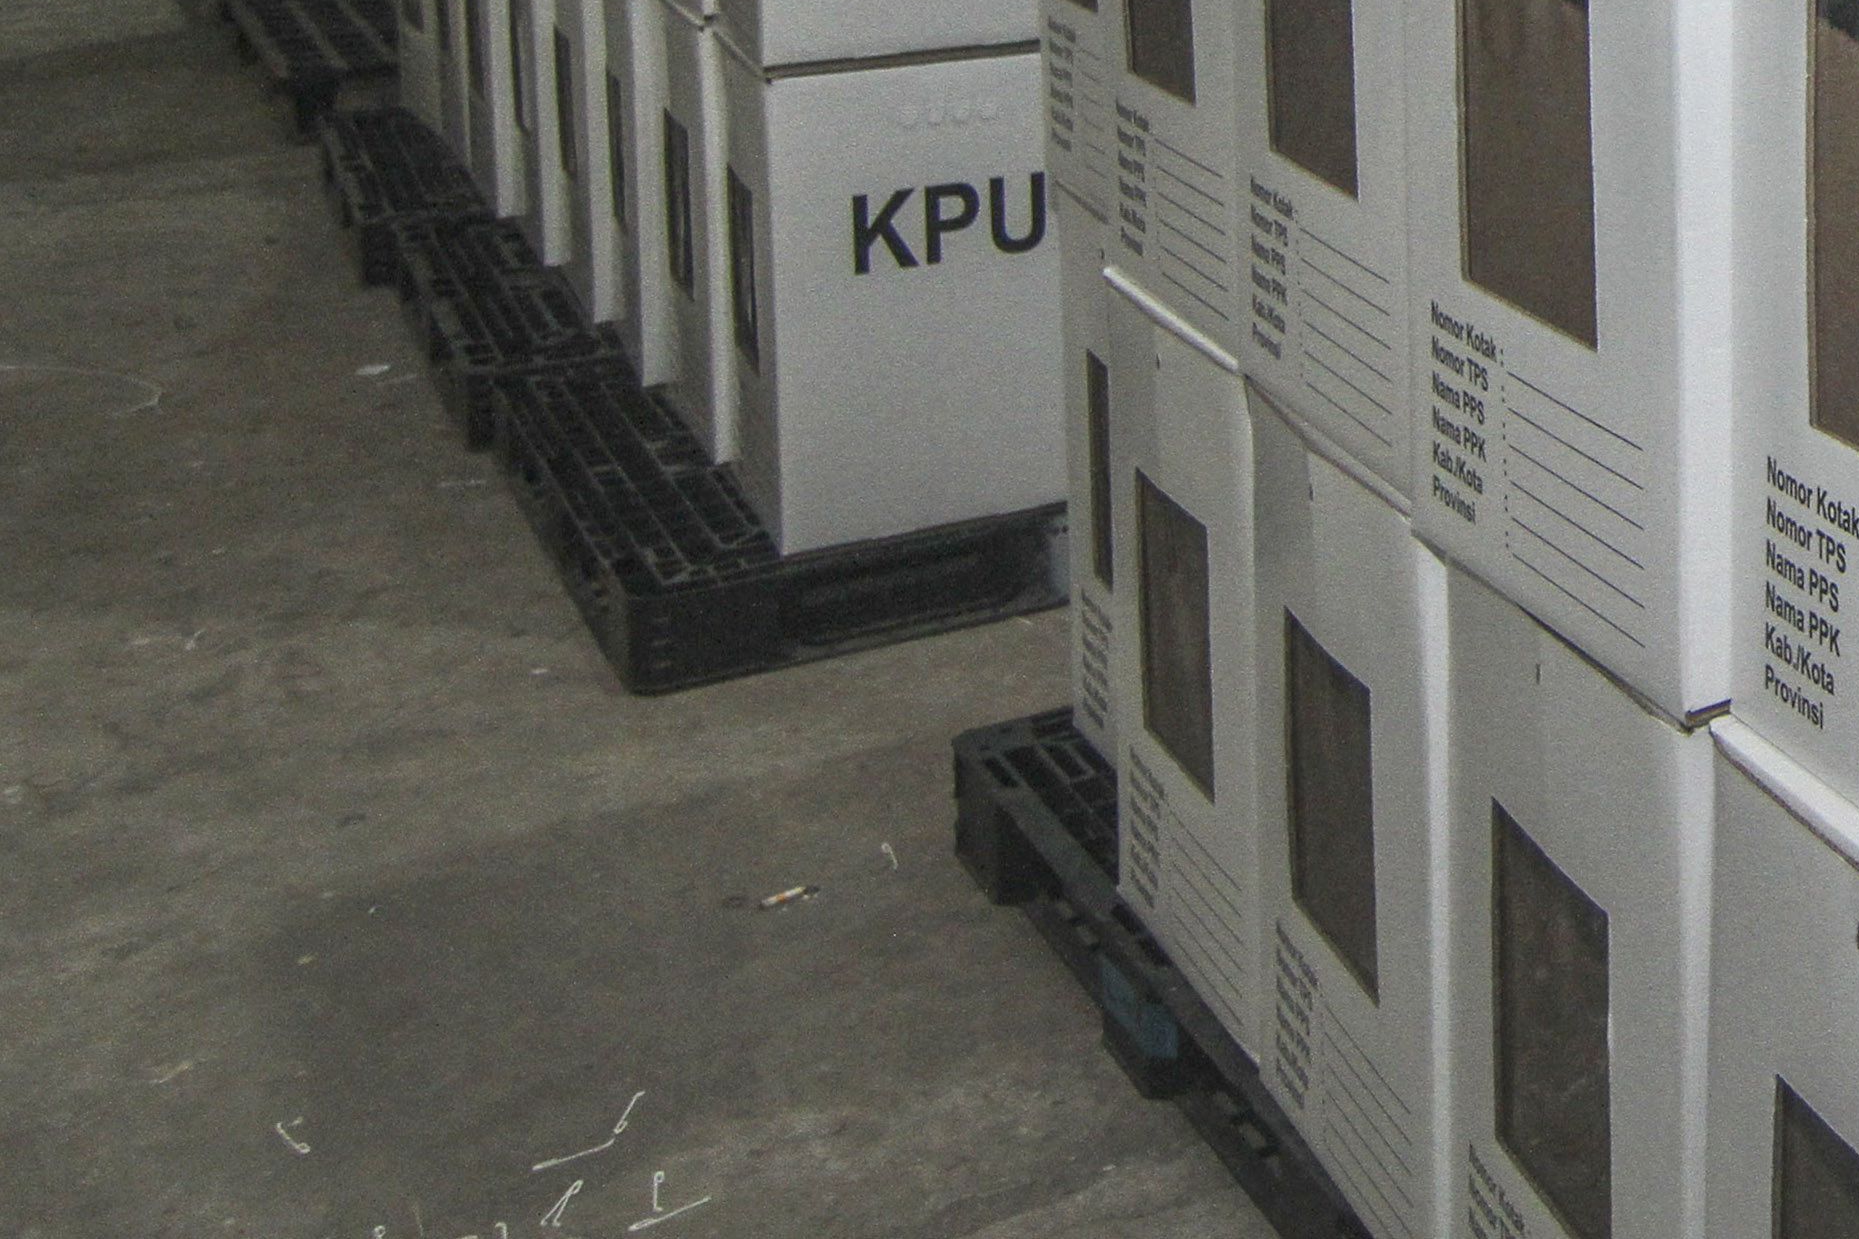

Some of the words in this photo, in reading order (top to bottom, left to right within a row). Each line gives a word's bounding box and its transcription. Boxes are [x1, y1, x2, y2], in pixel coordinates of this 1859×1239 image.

[852, 171, 1046, 275] KPU
[1431, 300, 1464, 340] Nomor
[1466, 323, 1497, 362] Kotak
[1432, 335, 1464, 376] Nomor
[1467, 357, 1488, 392] TPS
[1432, 370, 1460, 410] Nama
[1463, 391, 1485, 425] PPS
[1433, 406, 1461, 445] Nama
[1464, 426, 1486, 462] PPK
[1433, 474, 1475, 524] Provinsi
[1767, 456, 1812, 508] Nomor
[1817, 486, 1859, 539] Kotak
[1767, 496, 1812, 550] Nomor
[1816, 529, 1846, 574] TPS
[1766, 539, 1804, 590] Nama
[1809, 568, 1839, 613] PPS
[1766, 581, 1804, 632] Nama
[1809, 611, 1840, 657] PPK
[1765, 664, 1824, 730] Provinsi
